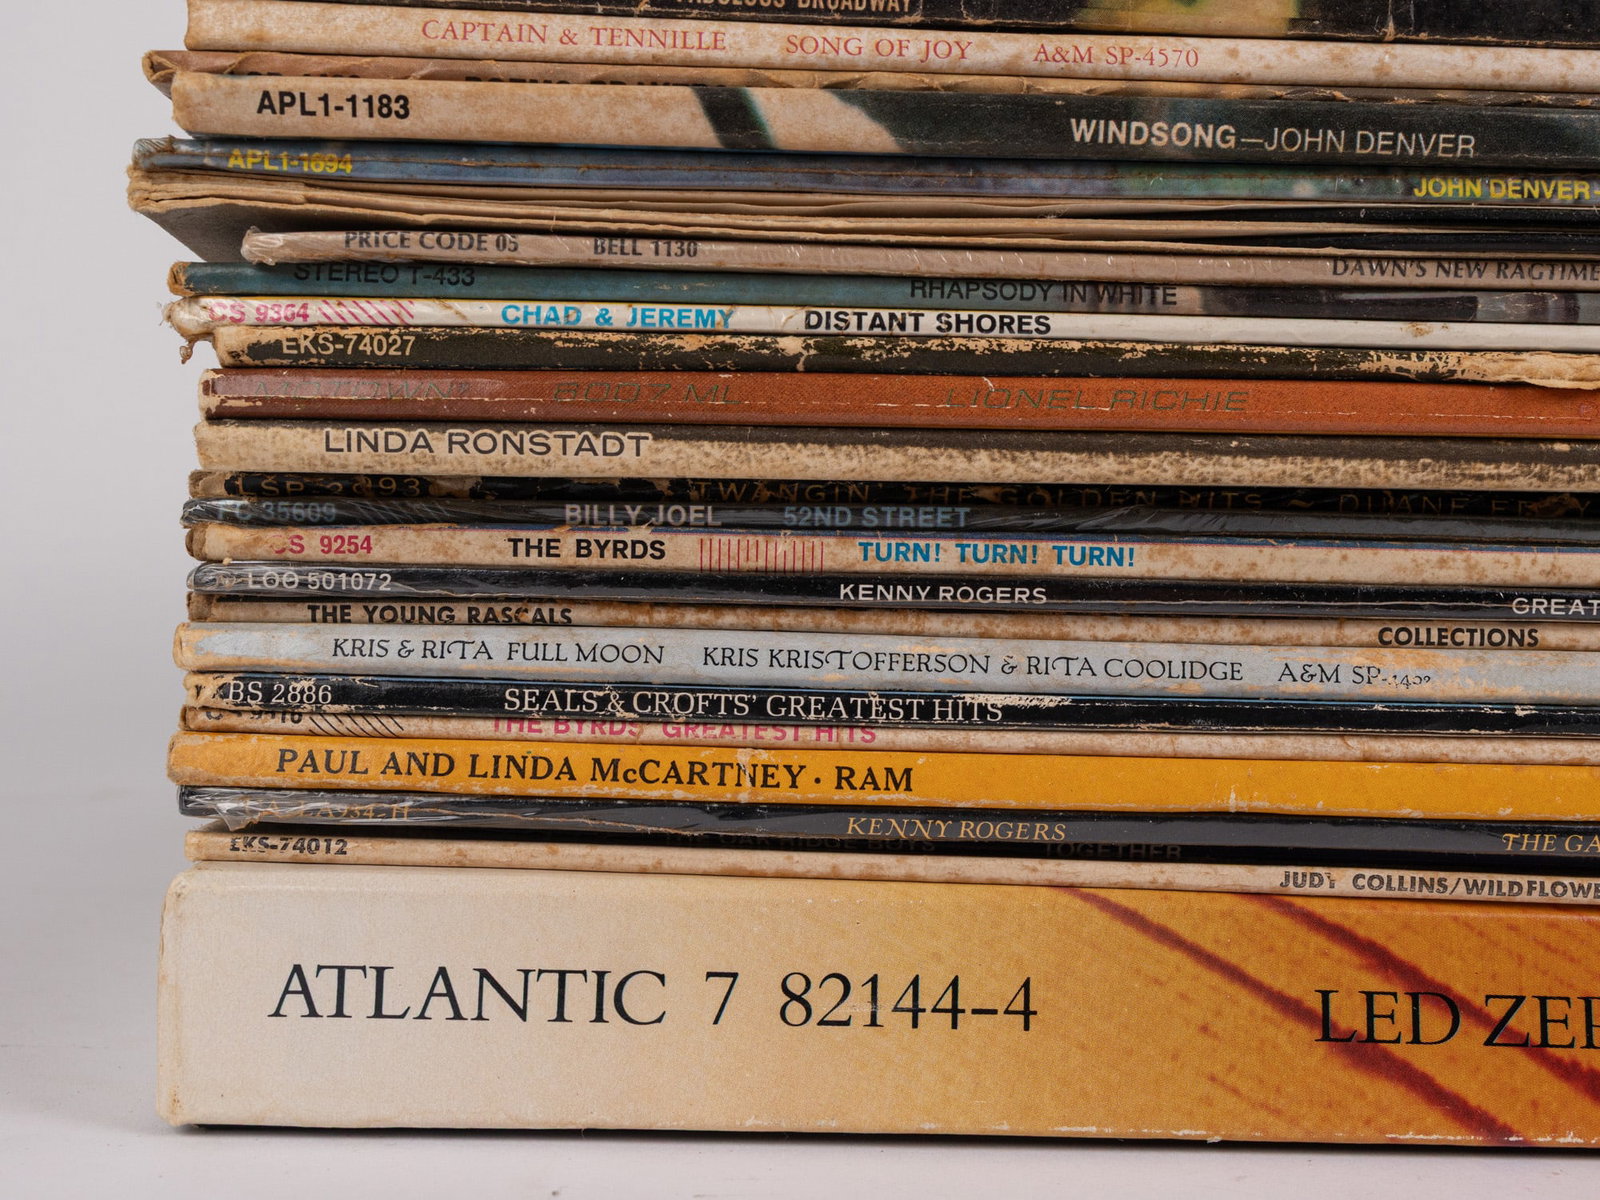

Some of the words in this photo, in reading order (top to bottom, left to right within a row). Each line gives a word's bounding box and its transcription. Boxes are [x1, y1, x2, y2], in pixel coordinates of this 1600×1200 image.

[422, 18, 548, 43] CAPTAIN
[559, 28, 578, 45] &
[590, 26, 727, 50] TENNILLE
[786, 34, 863, 57] SONG
[875, 38, 911, 58] OF
[919, 39, 974, 63] JOY
[1033, 43, 1094, 64] A&M
[1105, 46, 1200, 68] SP-4570
[256, 90, 411, 119] APL1-1183
[1355, 130, 1476, 158] DENVER
[227, 148, 353, 173] APL1-1694
[1413, 176, 1482, 198] JOHN
[344, 231, 411, 250] PRICE
[419, 232, 488, 252] CODE
[495, 234, 520, 253] 05
[593, 237, 643, 257] BELL
[653, 239, 698, 258] 1130
[294, 263, 400, 284] STEREO
[410, 266, 475, 287] T-433
[1332, 257, 1428, 278] DAWN'S
[1435, 260, 1488, 280] NEW
[1495, 261, 1600, 283] RAGTIME
[909, 279, 1053, 302] RHAPSODY
[1062, 284, 1087, 304] IN
[1096, 285, 1178, 307] WHITE
[208, 301, 247, 323] CS
[255, 302, 310, 323] 9364
[501, 304, 582, 326] CHAD
[595, 307, 614, 327] &
[626, 308, 737, 330] JEREMY
[805, 310, 925, 333] DISTANT
[935, 314, 1051, 335] SHORES
[281, 332, 416, 356] EKS-74027
[946, 387, 1095, 411] LIONEL
[1109, 388, 1250, 412] RICHIE
[324, 430, 434, 455] LINDA
[447, 431, 651, 458] RONSTADT
[262, 501, 337, 522] 35609
[565, 503, 643, 526] BILLY
[651, 504, 722, 527] JOEL
[784, 505, 851, 527] 52ND
[861, 506, 971, 528] STREET
[319, 535, 373, 555] 9254
[507, 537, 562, 558] THE
[575, 538, 666, 560] BYRDS
[858, 541, 942, 563] TURN!
[956, 543, 1038, 565] TURN!
[1052, 545, 1136, 567] TURN!
[307, 572, 393, 592] 501072
[840, 583, 933, 602] KENNY
[939, 585, 1048, 605] ROGERS
[307, 604, 352, 624] THE
[362, 605, 456, 625] YOUNG
[466, 606, 573, 625] RASCALS
[1377, 626, 1540, 649] COLLECTIONS
[332, 637, 391, 658] KRIS
[397, 639, 416, 659] &
[421, 640, 494, 660] RITA
[506, 641, 568, 663] FULL
[574, 643, 666, 665] MOON
[703, 646, 759, 668] KRIS
[768, 648, 991, 675] KRISTOFFERSON
[1000, 655, 1018, 675] &
[1026, 655, 1098, 677] RITA
[1104, 657, 1244, 682] COOLIDGE
[1276, 663, 1341, 684] A&M
[227, 680, 263, 704] BS
[271, 682, 333, 705] 2886
[503, 687, 600, 713] SEALS
[607, 692, 626, 713] &
[632, 691, 757, 715] CROFTS'
[765, 694, 927, 720] GREATEST
[933, 698, 1004, 723] HITS
[661, 722, 801, 742] GREATEST
[814, 725, 877, 744] HITS
[275, 748, 369, 774] PAUL
[379, 751, 456, 778] AND
[467, 754, 577, 781] LINDA
[590, 757, 807, 789] McCARTNEY
[834, 765, 914, 793] RAM
[847, 817, 953, 840] KENNY
[958, 819, 1067, 842] ROGERS
[1502, 832, 1557, 852] THE
[229, 835, 349, 856] EKS-74012
[267, 963, 667, 1024] ATLANTIC
[703, 970, 740, 1026] 7
[779, 971, 1038, 1033] 82144-4
[1313, 988, 1461, 1045] LED
